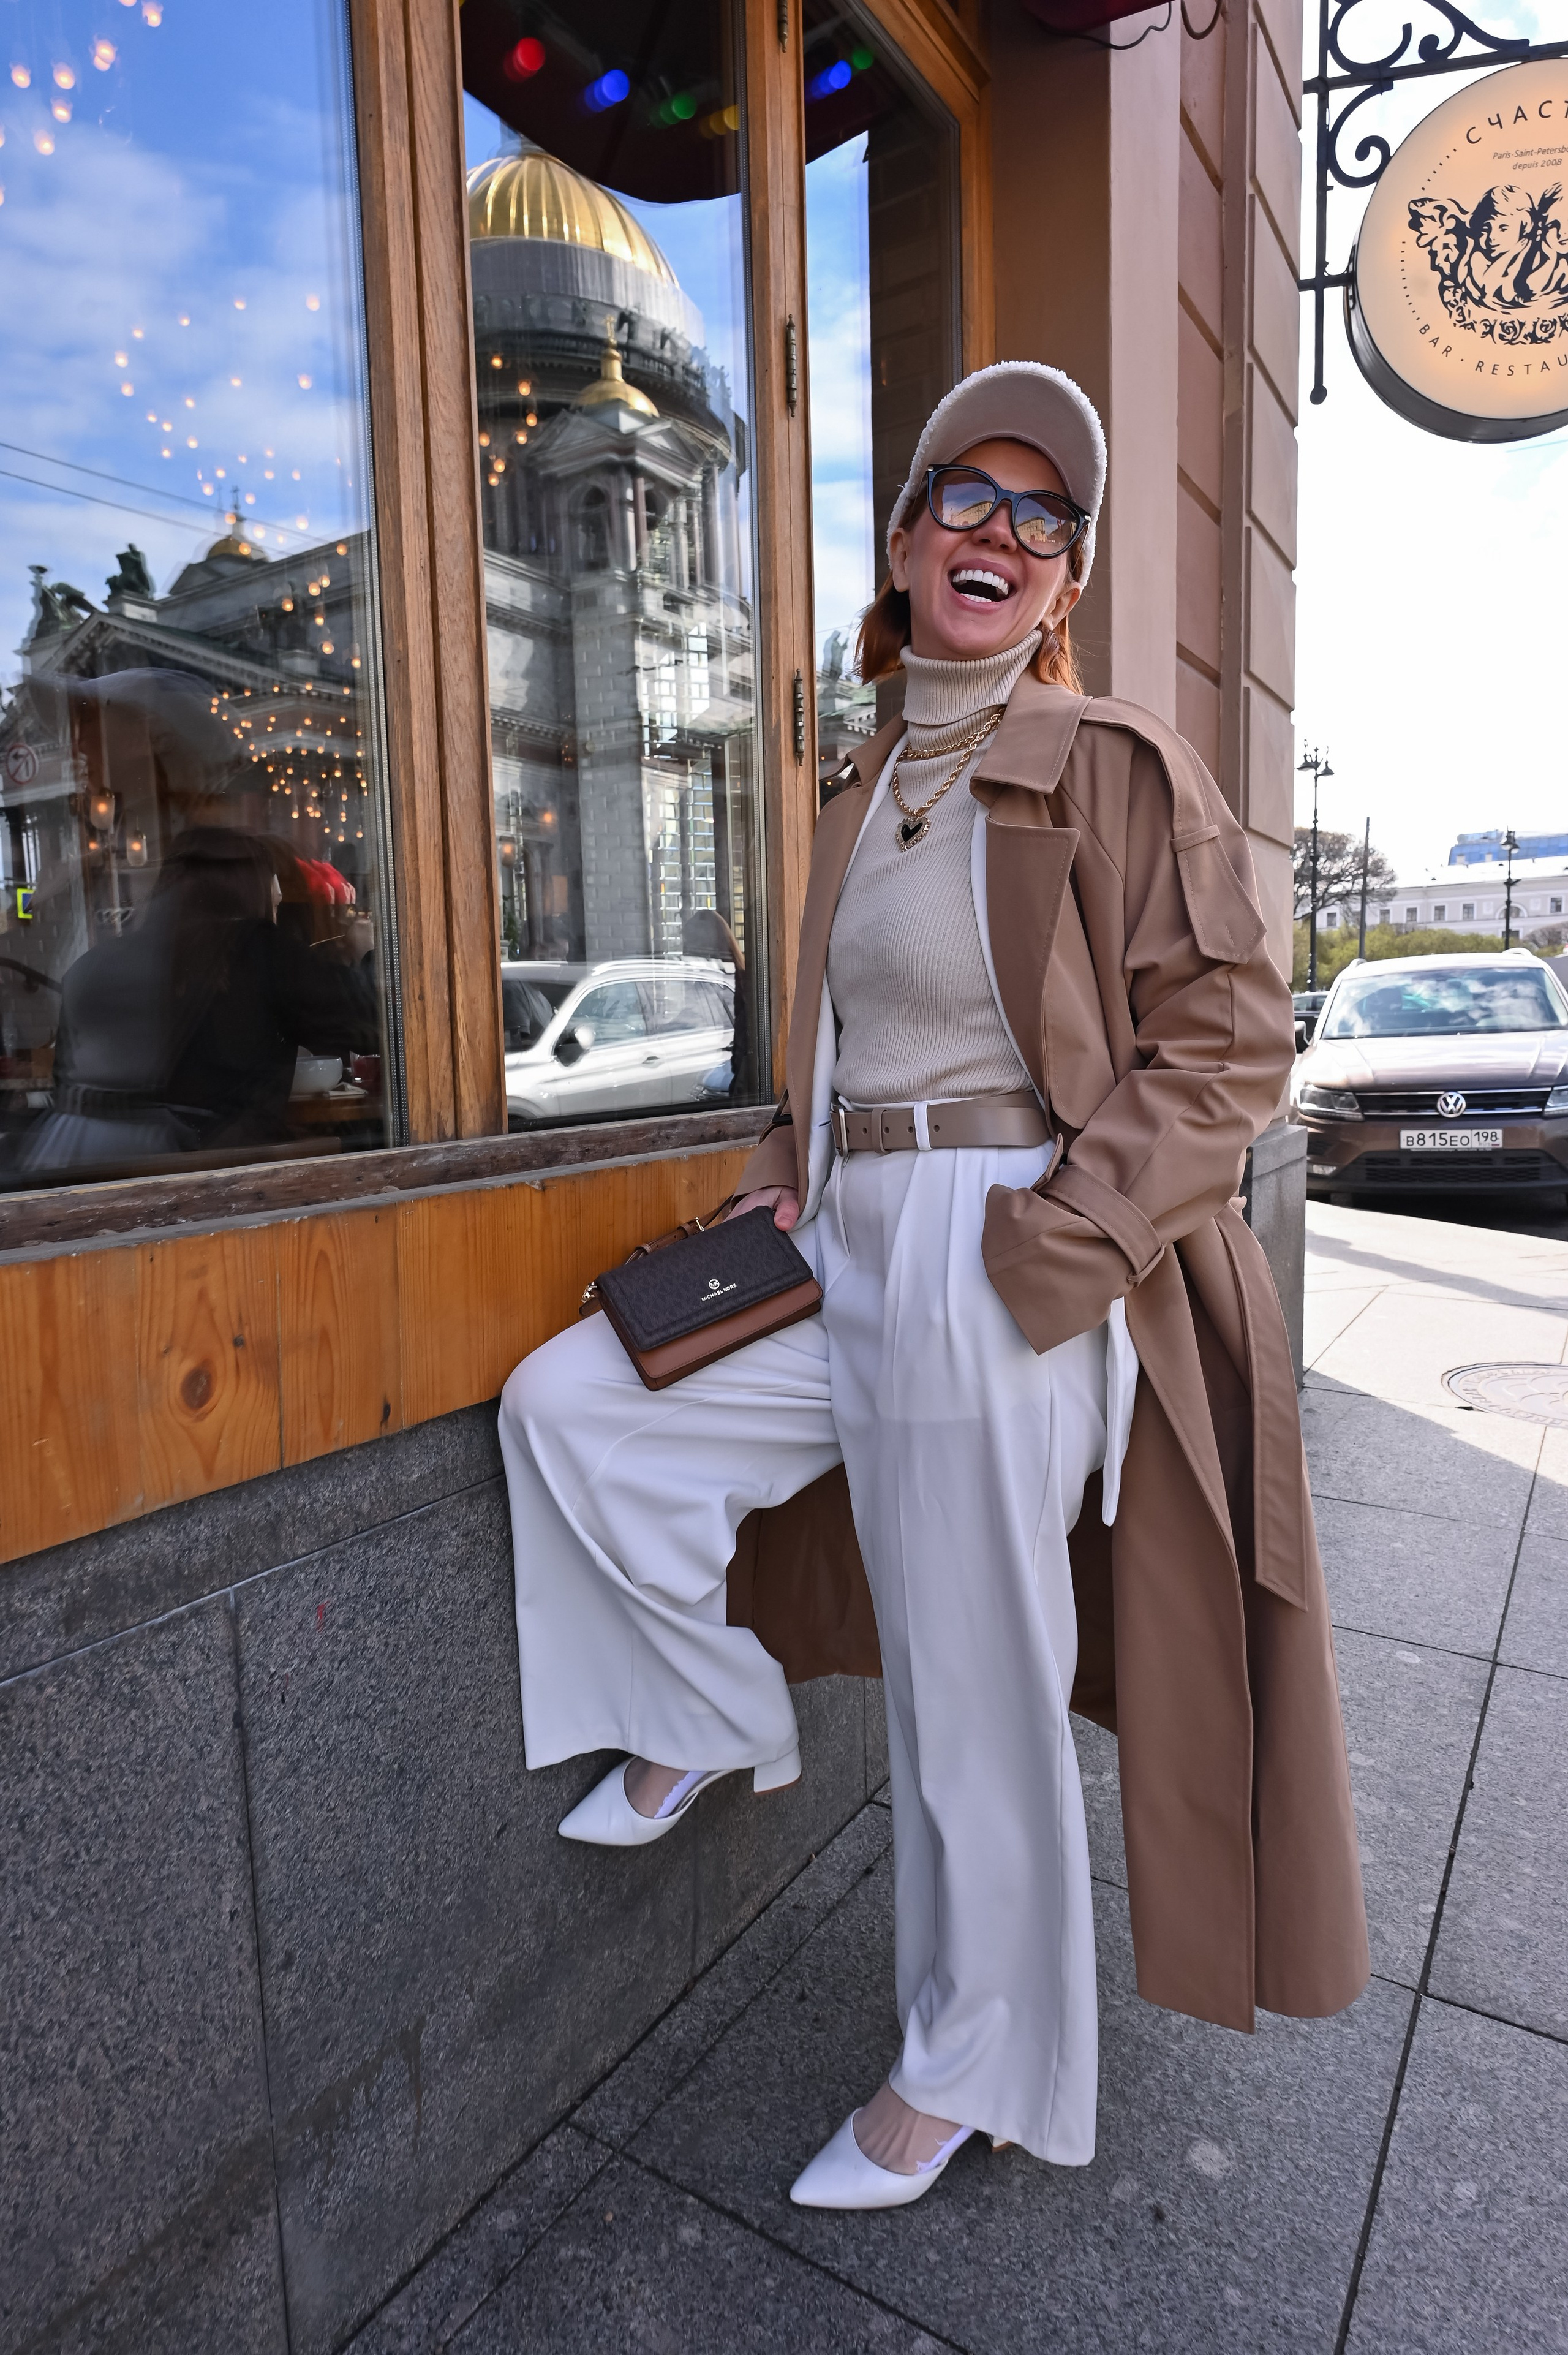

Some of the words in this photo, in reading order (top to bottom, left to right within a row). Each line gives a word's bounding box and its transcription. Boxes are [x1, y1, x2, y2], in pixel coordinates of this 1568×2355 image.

[1512, 161, 1539, 171] depuis
[1540, 158, 1562, 167] 2008
[1419, 323, 1452, 357] BAR
[1475, 354, 1568, 376] RESTAU
[1474, 1132, 1498, 1142] 198
[701, 1290, 723, 1302] MICHAEL
[723, 1283, 737, 1292] KORS
